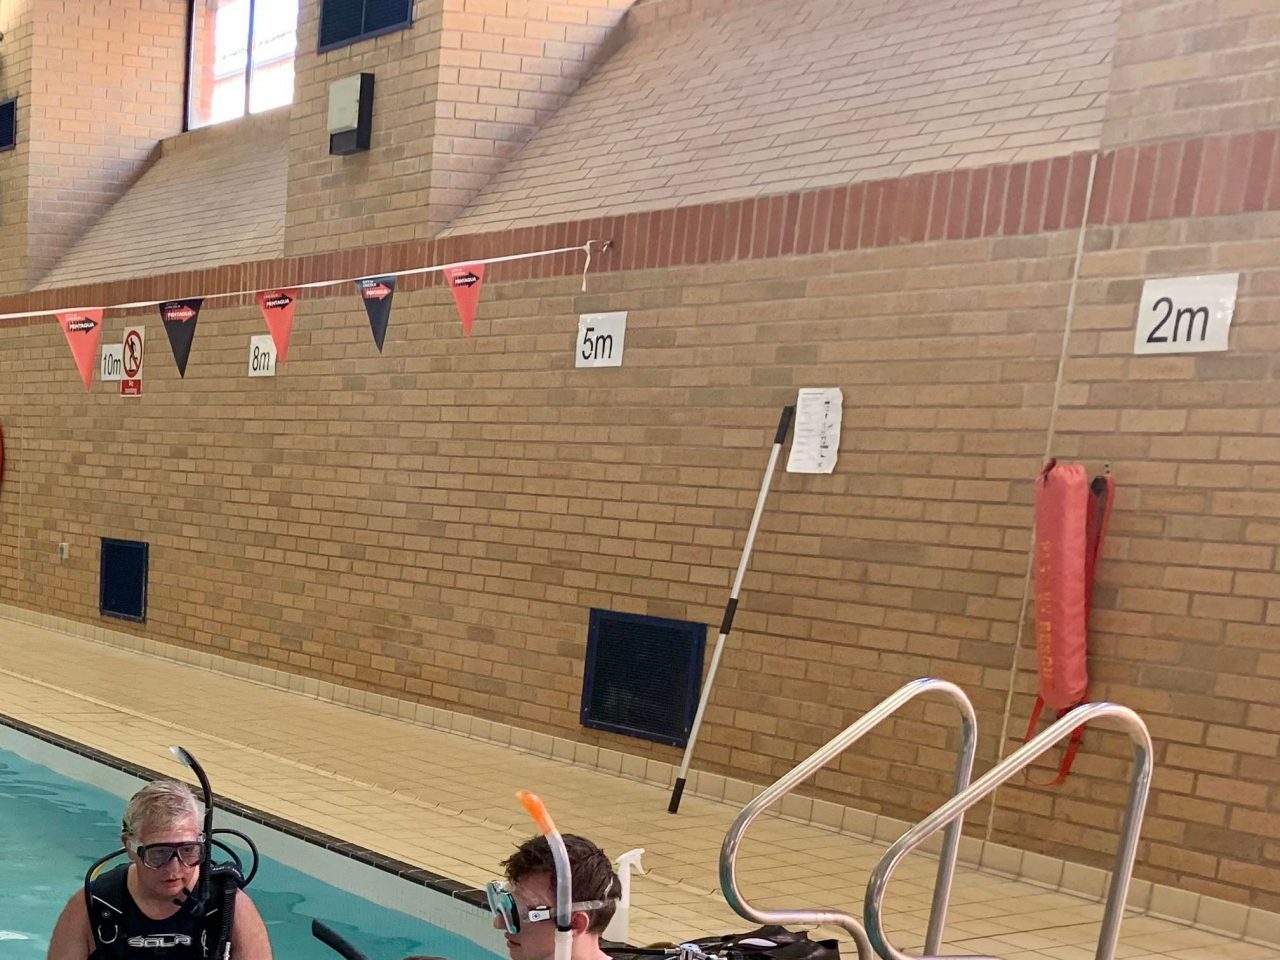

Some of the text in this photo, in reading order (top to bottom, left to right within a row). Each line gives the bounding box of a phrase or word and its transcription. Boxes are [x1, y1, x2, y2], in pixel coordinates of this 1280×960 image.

[1146, 296, 1209, 343] 2m
[252, 345, 270, 372] 8m
[582, 327, 613, 360] 5m
[103, 353, 121, 376] 10m
